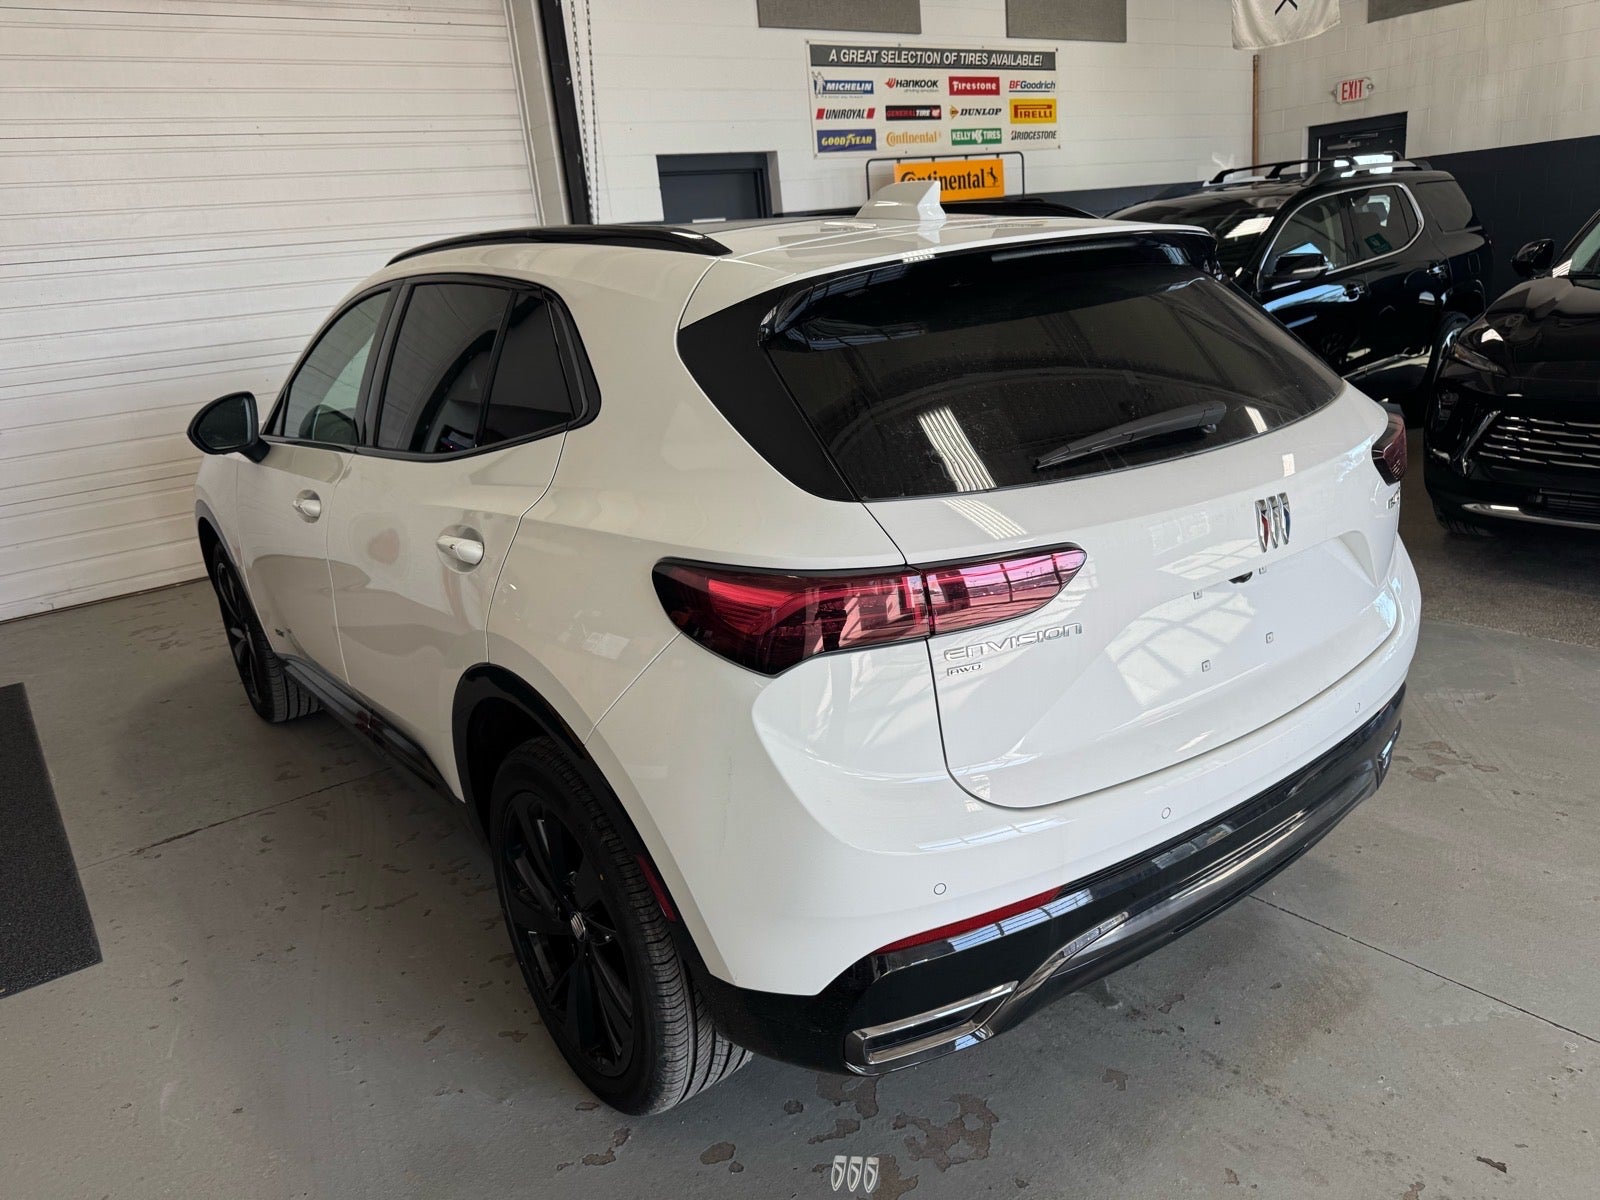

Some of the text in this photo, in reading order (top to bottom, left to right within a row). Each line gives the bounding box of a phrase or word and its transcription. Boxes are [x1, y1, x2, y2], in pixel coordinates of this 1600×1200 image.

[829, 49, 1043, 66] A GREAT SELECTION OF TIRES AVAILABLE!
[826, 82, 872, 91] MICHELIN
[952, 81, 997, 92] Firestone
[1009, 80, 1056, 89] BFGoodrich
[1342, 79, 1364, 101] EXIT
[825, 108, 866, 120] UNIROYAL
[960, 108, 1002, 116] DUNLOP
[1014, 104, 1052, 118] PIRELLI
[821, 133, 872, 147] GOODYEAR
[886, 131, 937, 146] Continental
[952, 131, 971, 141] KELLY
[1011, 130, 1057, 141] BRIDGESTONE
[900, 168, 985, 192] inental
[944, 622, 1082, 661] ENVISION
[948, 662, 982, 676] AWD
